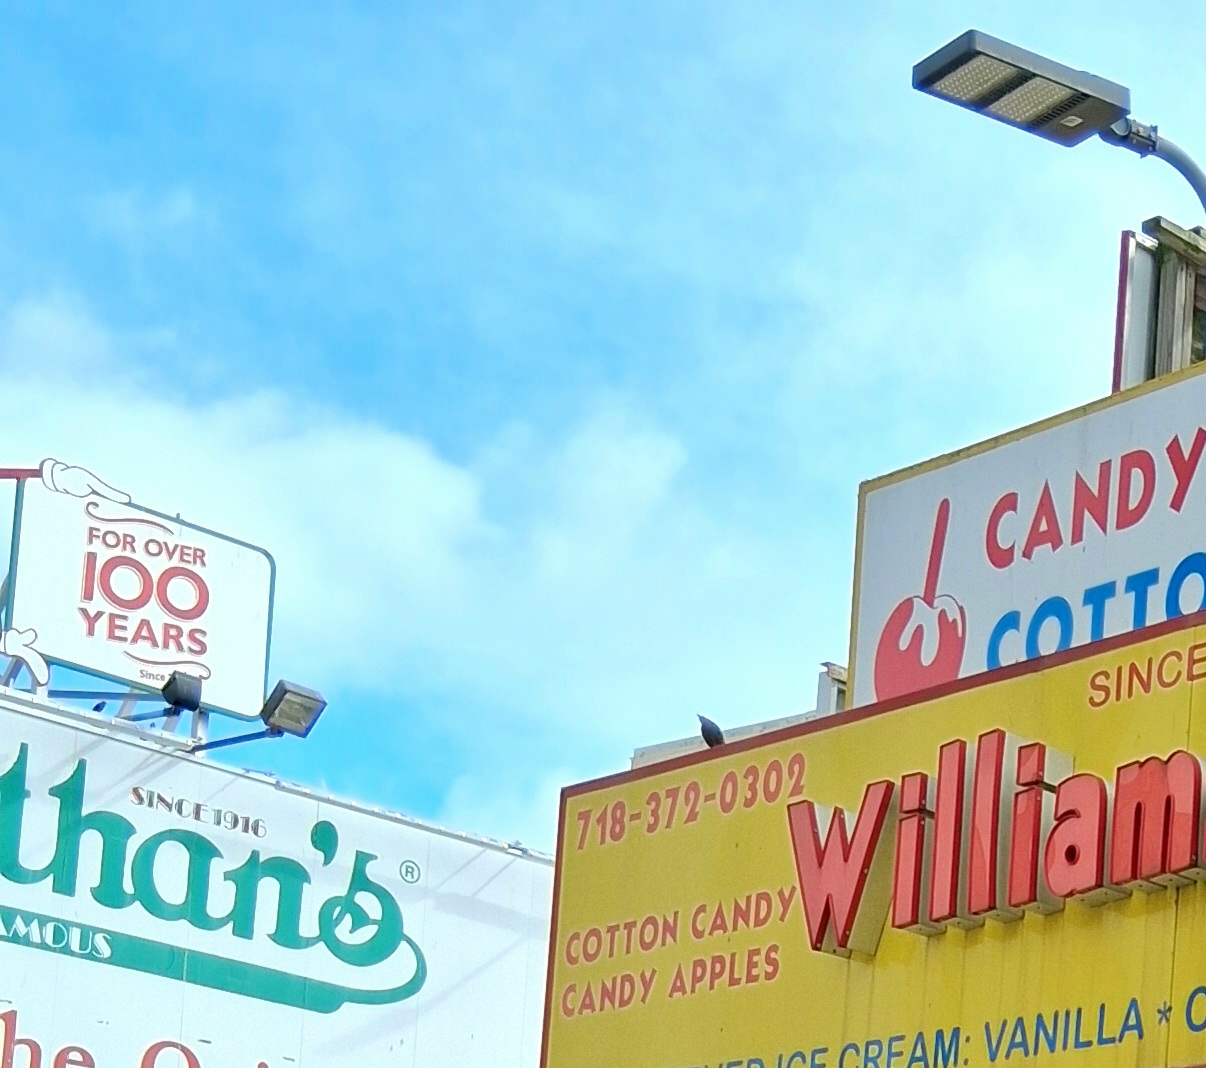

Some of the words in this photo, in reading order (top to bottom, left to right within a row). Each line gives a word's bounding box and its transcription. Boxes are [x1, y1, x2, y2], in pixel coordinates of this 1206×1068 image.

[87, 527, 137, 553] FOR
[144, 539, 207, 568] OVER
[80, 551, 210, 621] 100
[78, 607, 209, 657] YEARS
[139, 669, 166, 682] Since
[577, 752, 807, 851] 718-372-0302
[565, 910, 679, 967] COTTON
[690, 884, 797, 940] CANDY
[561, 967, 658, 1019] CANDY
[668, 943, 780, 999] APPLES
[985, 997, 1144, 1062] VANILLA
